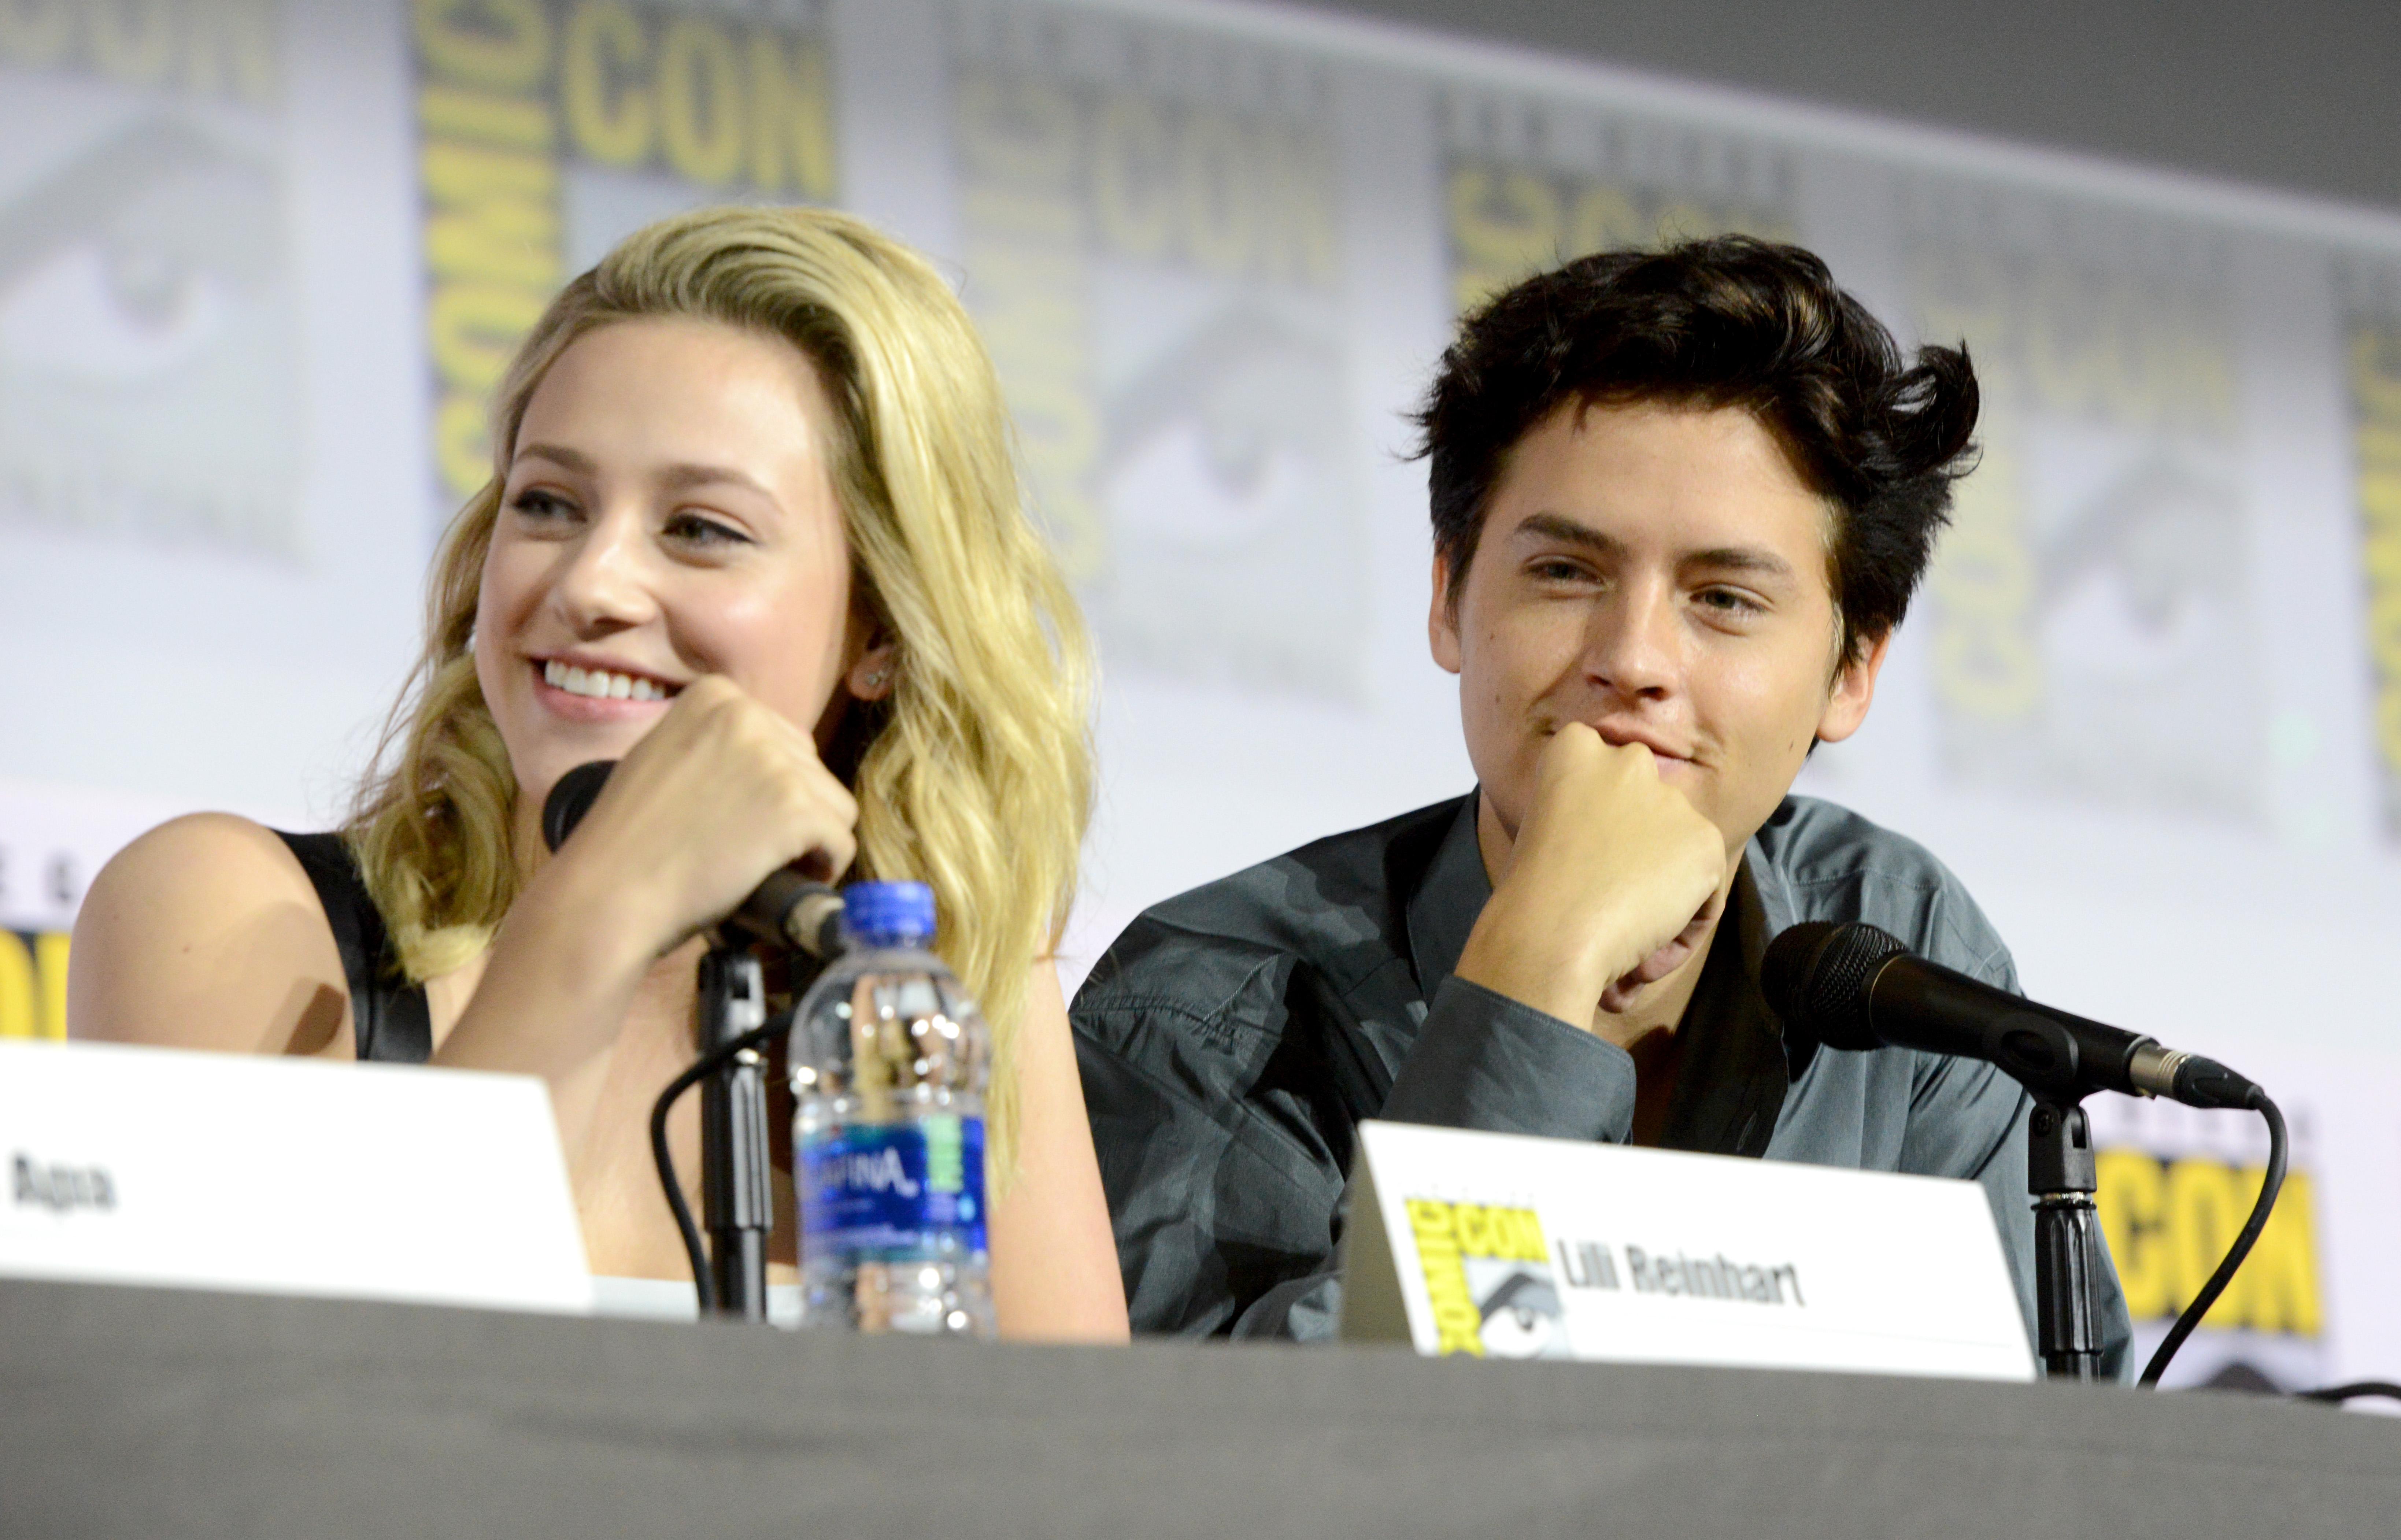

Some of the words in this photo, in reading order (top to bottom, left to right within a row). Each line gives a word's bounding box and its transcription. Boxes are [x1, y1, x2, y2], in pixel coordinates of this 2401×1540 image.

[563, 7, 837, 200] CON
[1455, 1202, 1550, 1265] CON
[1556, 1237, 1621, 1291] Lili
[1624, 1242, 1807, 1308] Reinhart
[2094, 1143, 2324, 1341] CON
